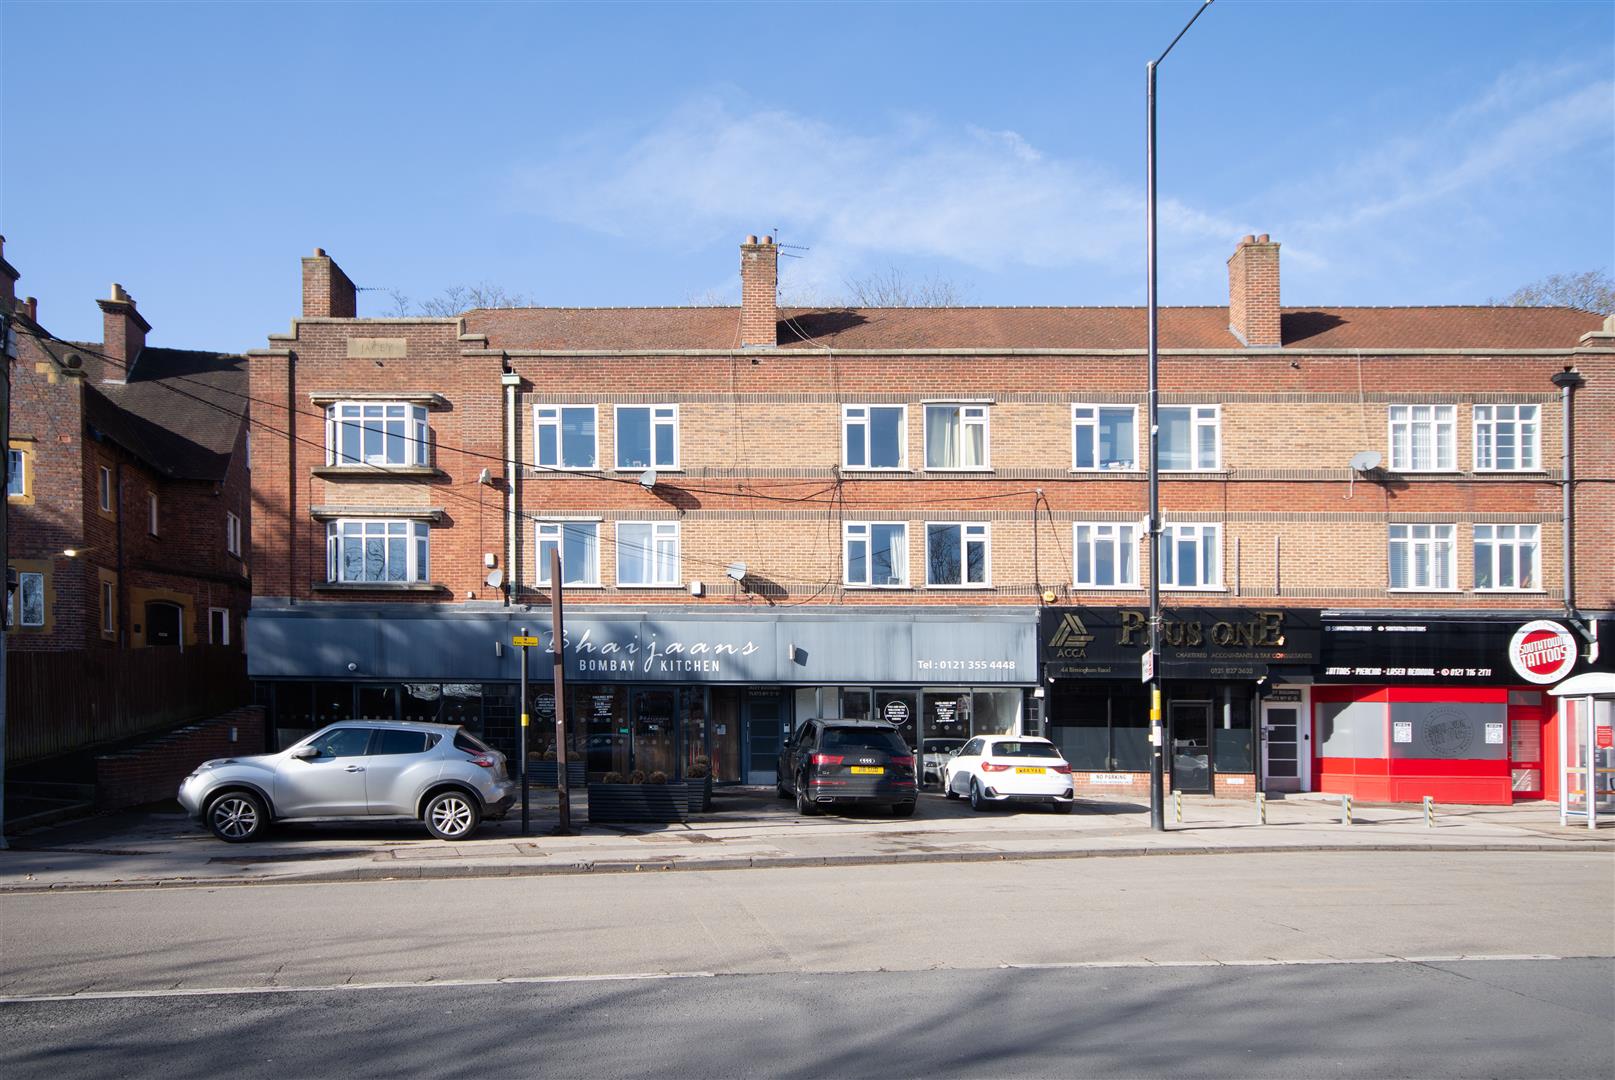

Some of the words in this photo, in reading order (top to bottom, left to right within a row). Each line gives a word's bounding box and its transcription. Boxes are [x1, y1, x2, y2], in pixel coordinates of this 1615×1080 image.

[1057, 648, 1087, 658] ACCA
[1520, 645, 1567, 669] TATTOOS
[579, 659, 635, 672] BOMBAY
[660, 659, 720, 672] KITCHEN
[940, 660, 965, 670] 0121
[968, 660, 987, 670] 355
[989, 660, 1015, 670] 4448
